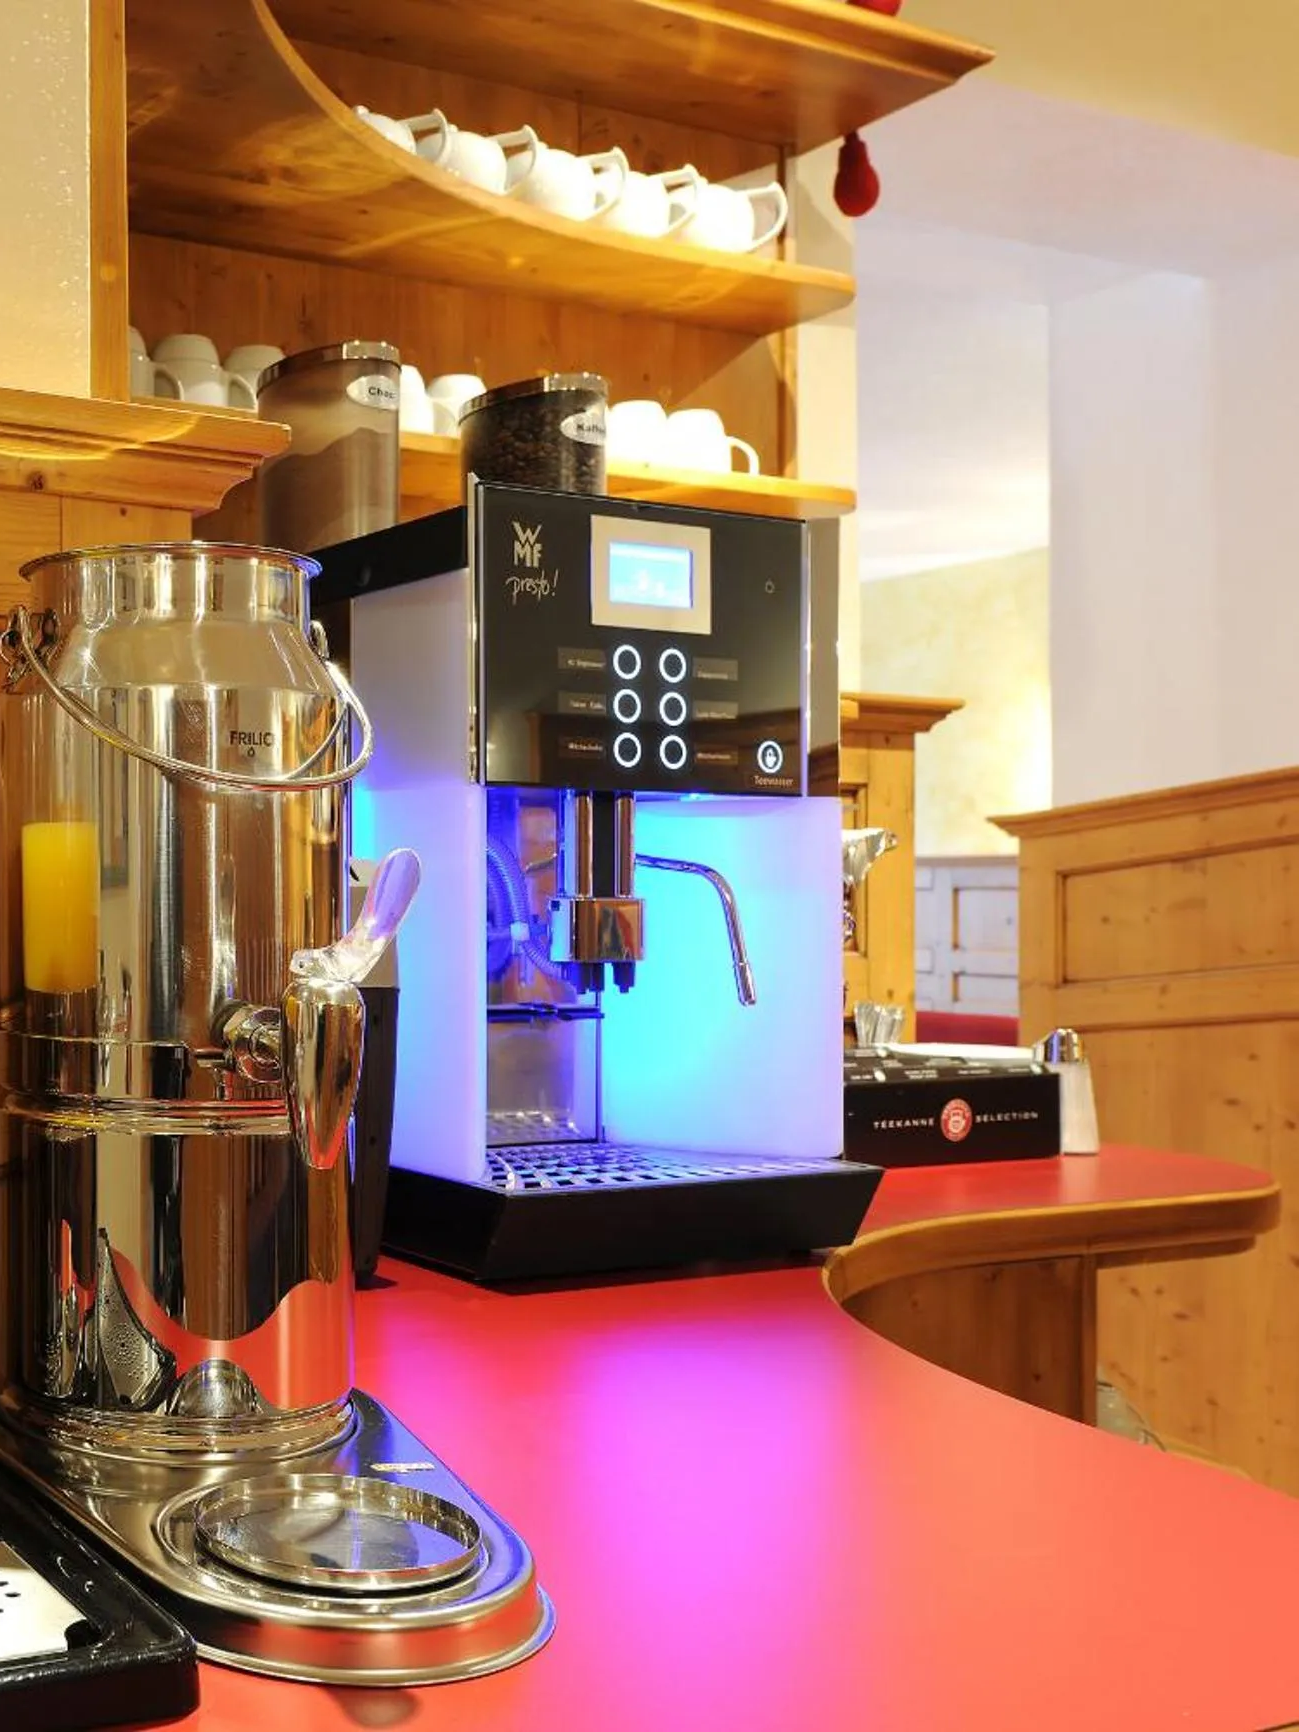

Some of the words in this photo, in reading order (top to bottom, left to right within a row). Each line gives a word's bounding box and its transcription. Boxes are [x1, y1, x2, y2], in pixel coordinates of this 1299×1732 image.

[512, 521, 542, 568] WMF
[505, 568, 559, 605] presto!
[873, 1118, 935, 1130] TEEKANNE
[975, 1111, 1039, 1124] SELECTION
